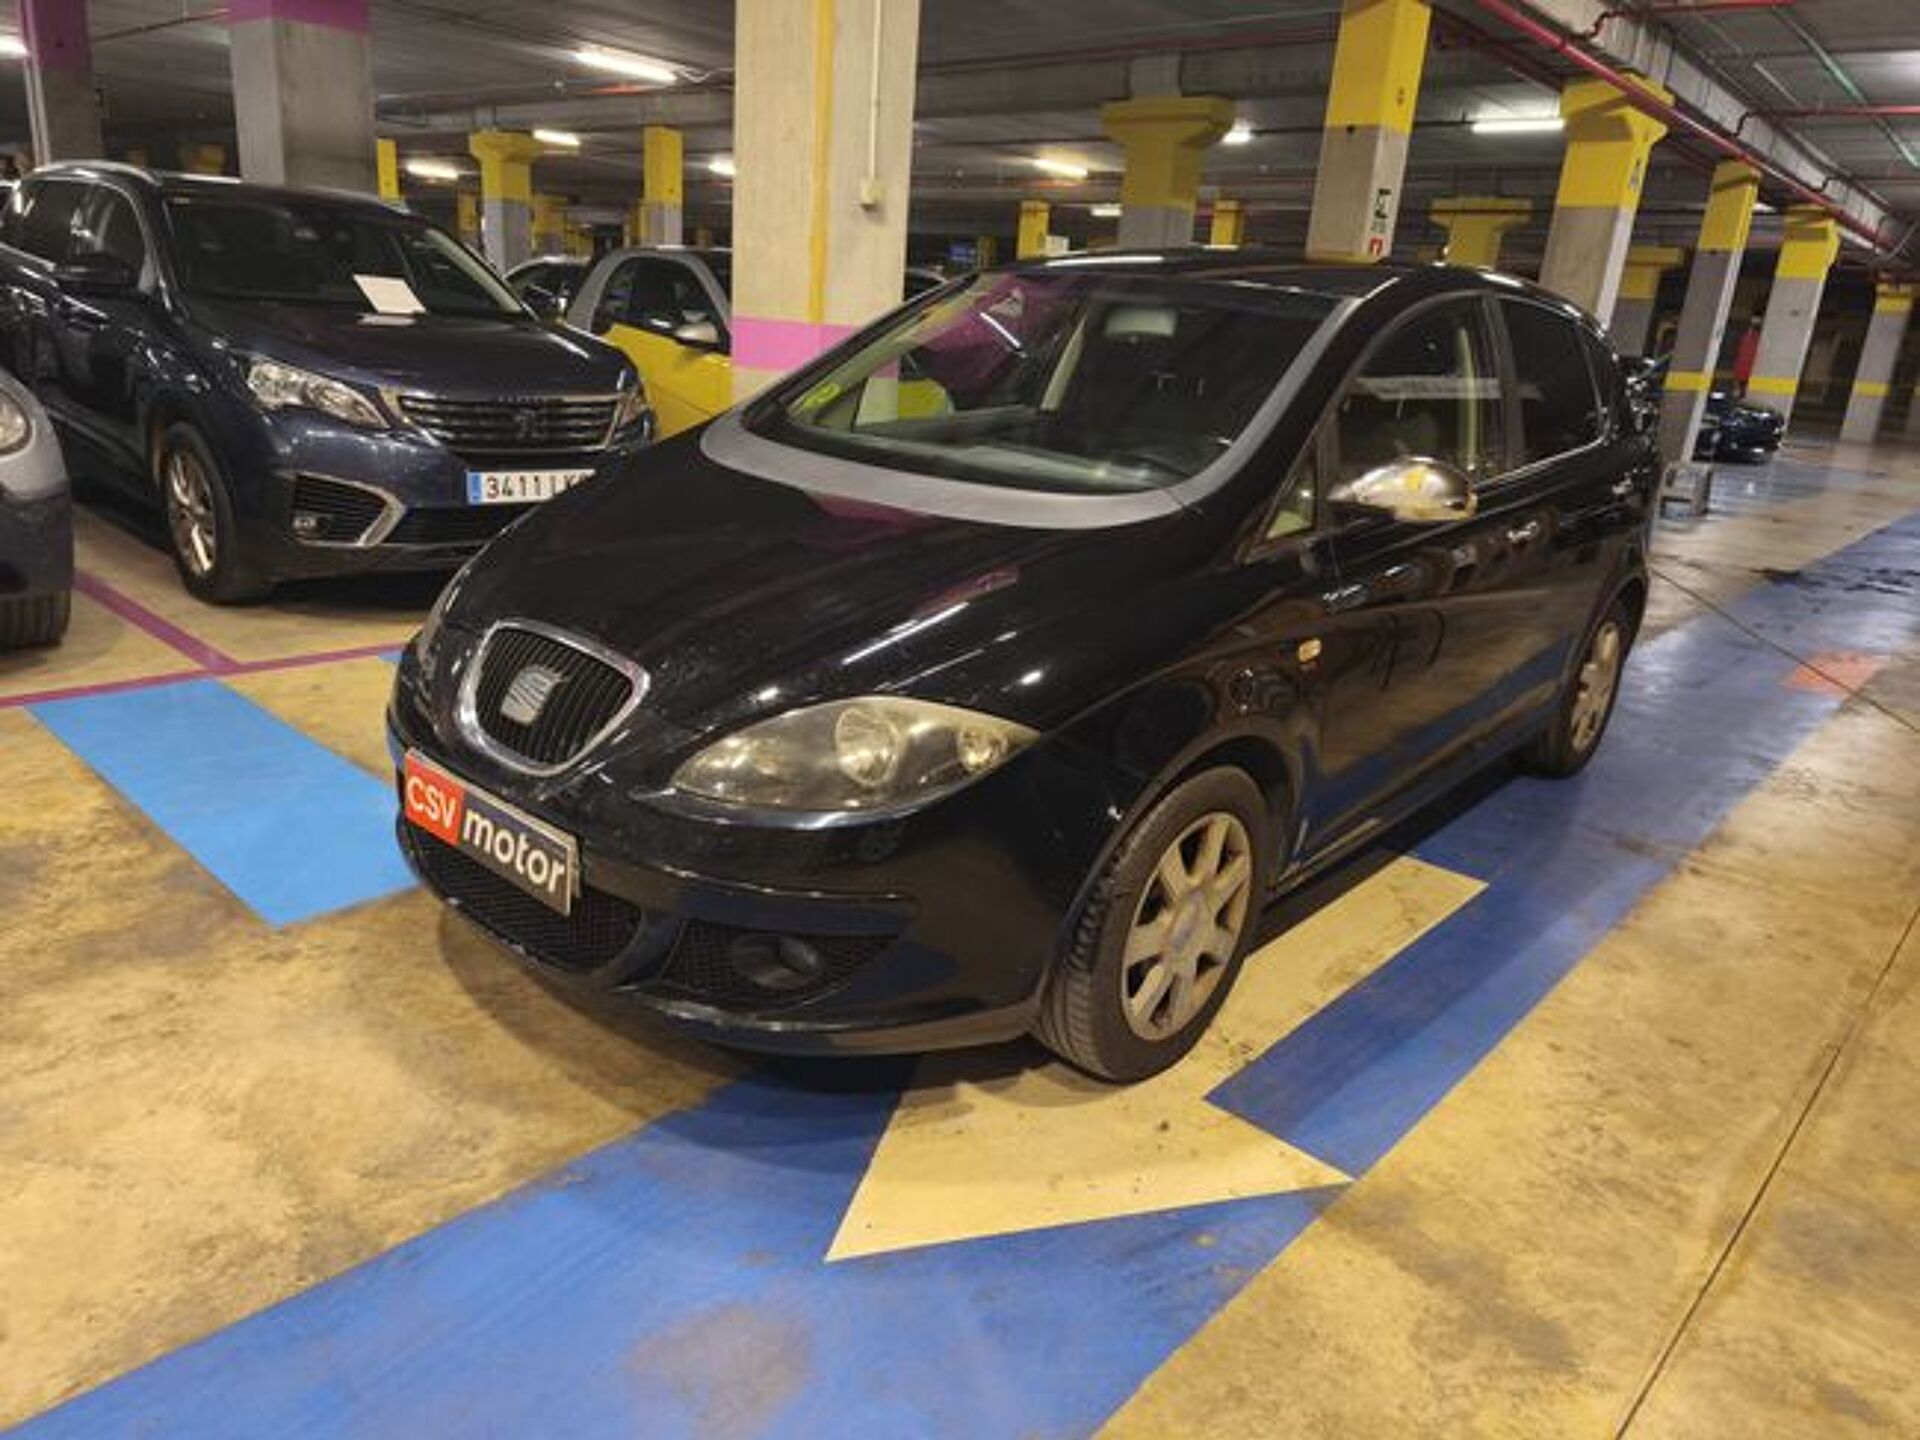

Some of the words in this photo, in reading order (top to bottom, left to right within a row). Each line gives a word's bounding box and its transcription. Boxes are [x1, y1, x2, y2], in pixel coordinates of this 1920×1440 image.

[486, 475, 542, 499] 3411
[407, 776, 456, 829] CSV
[463, 808, 566, 893] motor
